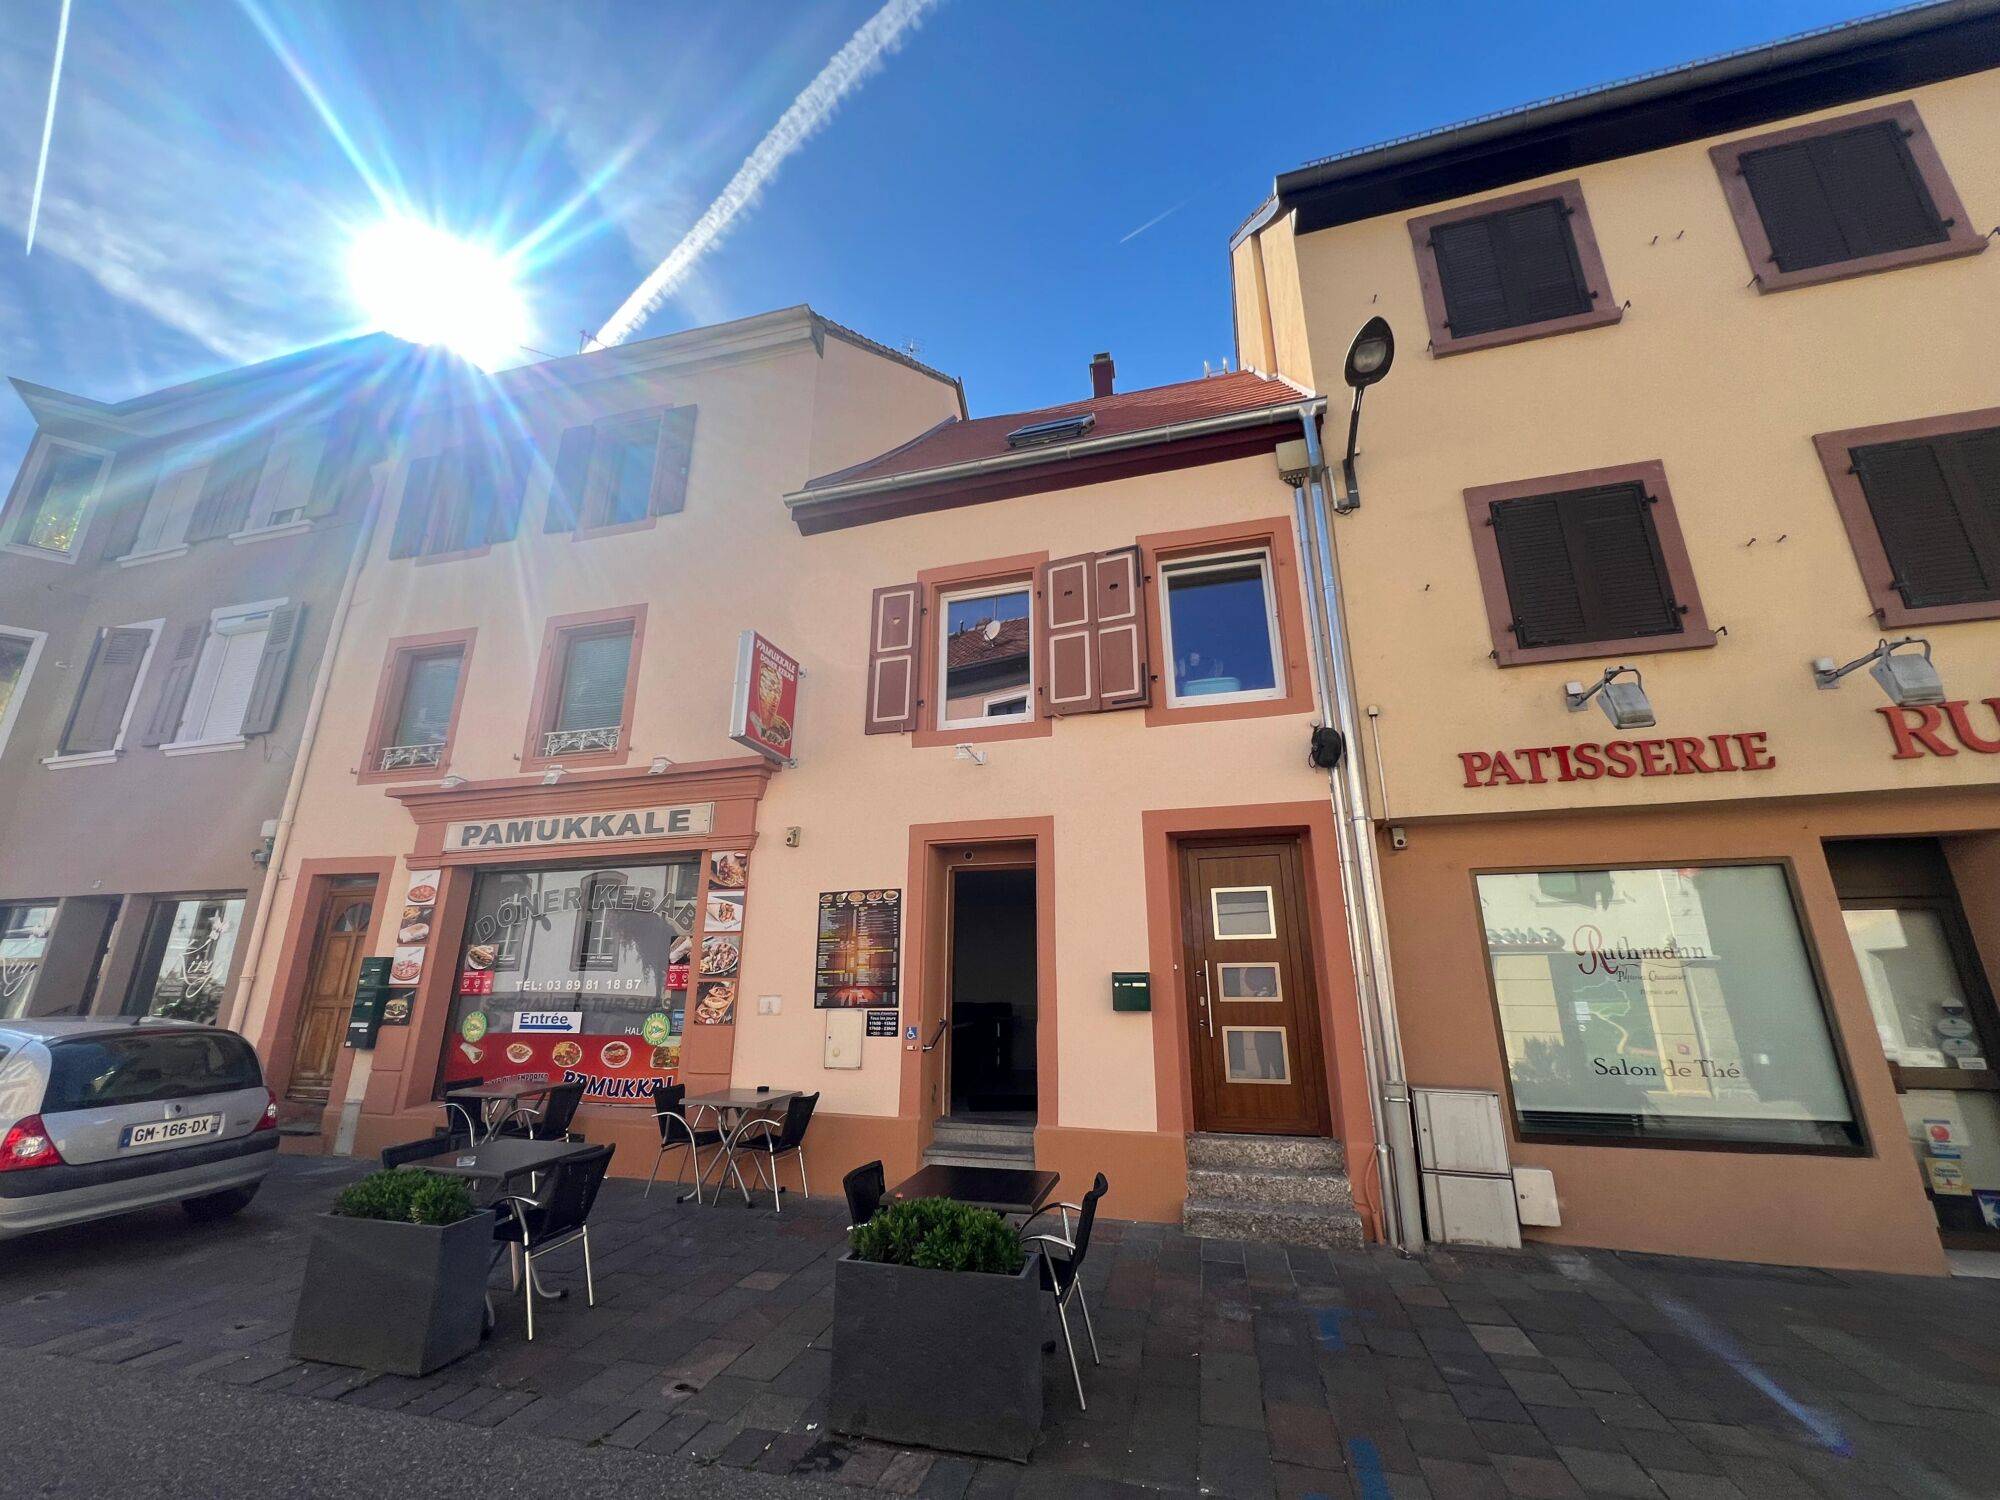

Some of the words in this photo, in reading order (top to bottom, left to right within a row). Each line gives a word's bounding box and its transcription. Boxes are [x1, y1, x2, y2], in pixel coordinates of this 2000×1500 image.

[1458, 732, 1776, 788] PATISSERIE
[461, 809, 691, 847] PAMUKKALE
[475, 886, 582, 942] DÖNER
[592, 884, 697, 933] KEBAB
[1572, 924, 1707, 975] Ruthmann
[546, 980, 561, 991] 03
[566, 980, 581, 991] 89
[585, 980, 599, 991] 81
[606, 979, 621, 991] 18
[626, 979, 642, 991] 87
[520, 1012, 569, 1025] Entrée
[1593, 1057, 1657, 1076] Salon
[1664, 1059, 1692, 1077] de
[1694, 1059, 1741, 1078] Thé
[134, 1118, 209, 1142] GM-166-DX
